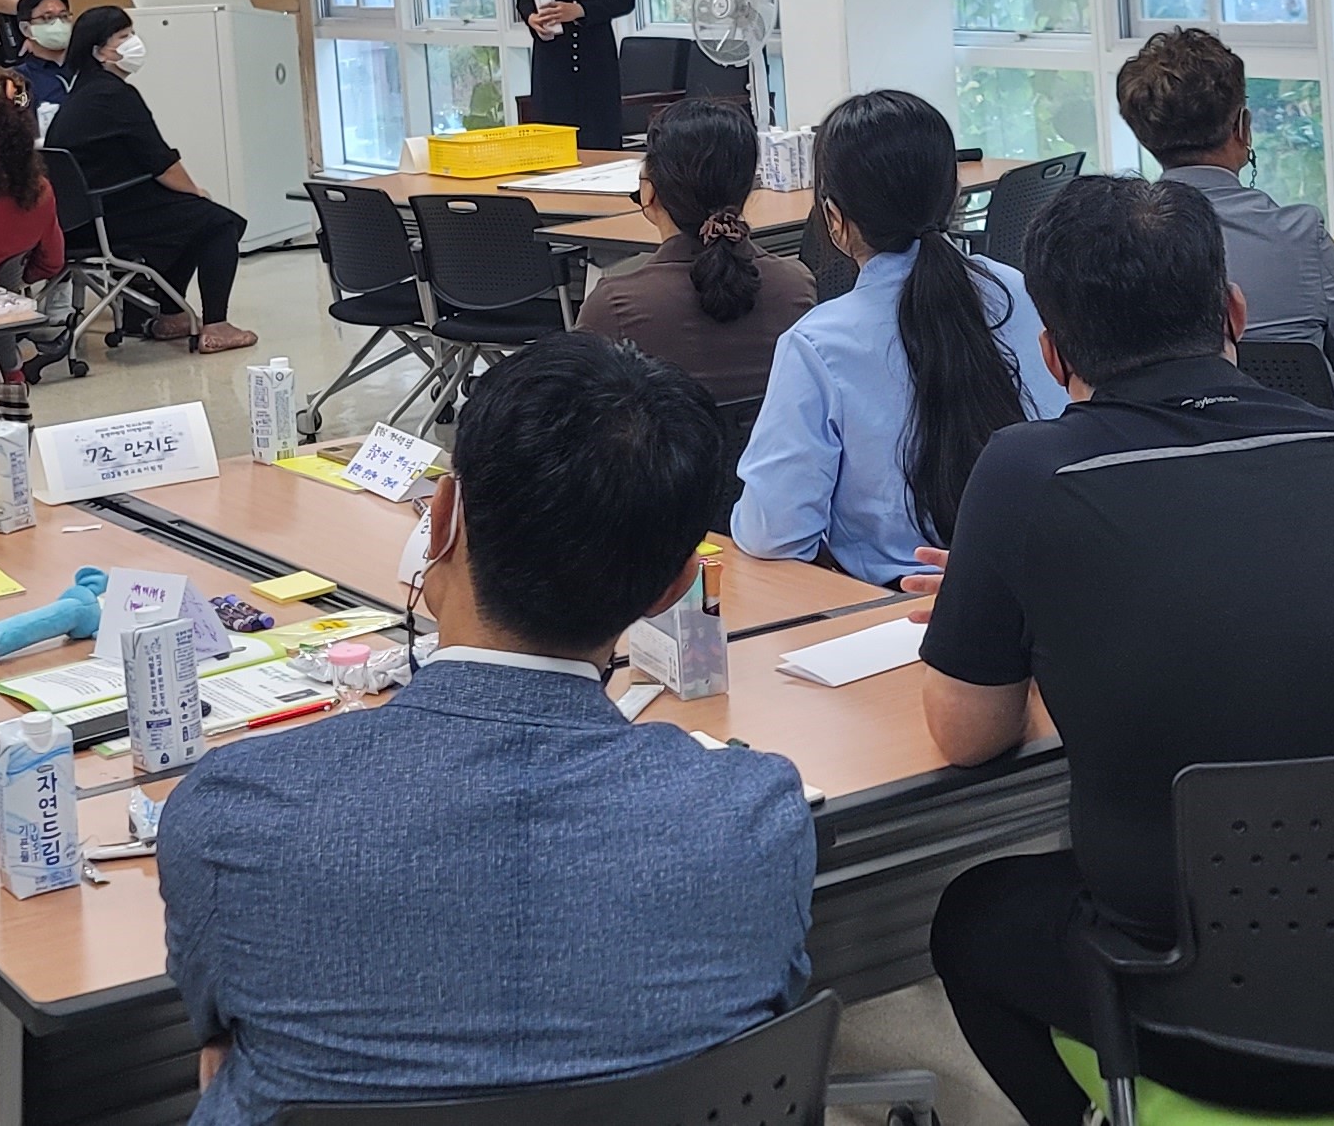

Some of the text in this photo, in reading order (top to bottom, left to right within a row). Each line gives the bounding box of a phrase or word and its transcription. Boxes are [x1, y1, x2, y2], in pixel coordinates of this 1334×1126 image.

[86, 436, 179, 464] 7조 만지도
[36, 771, 62, 866] 자연드림
